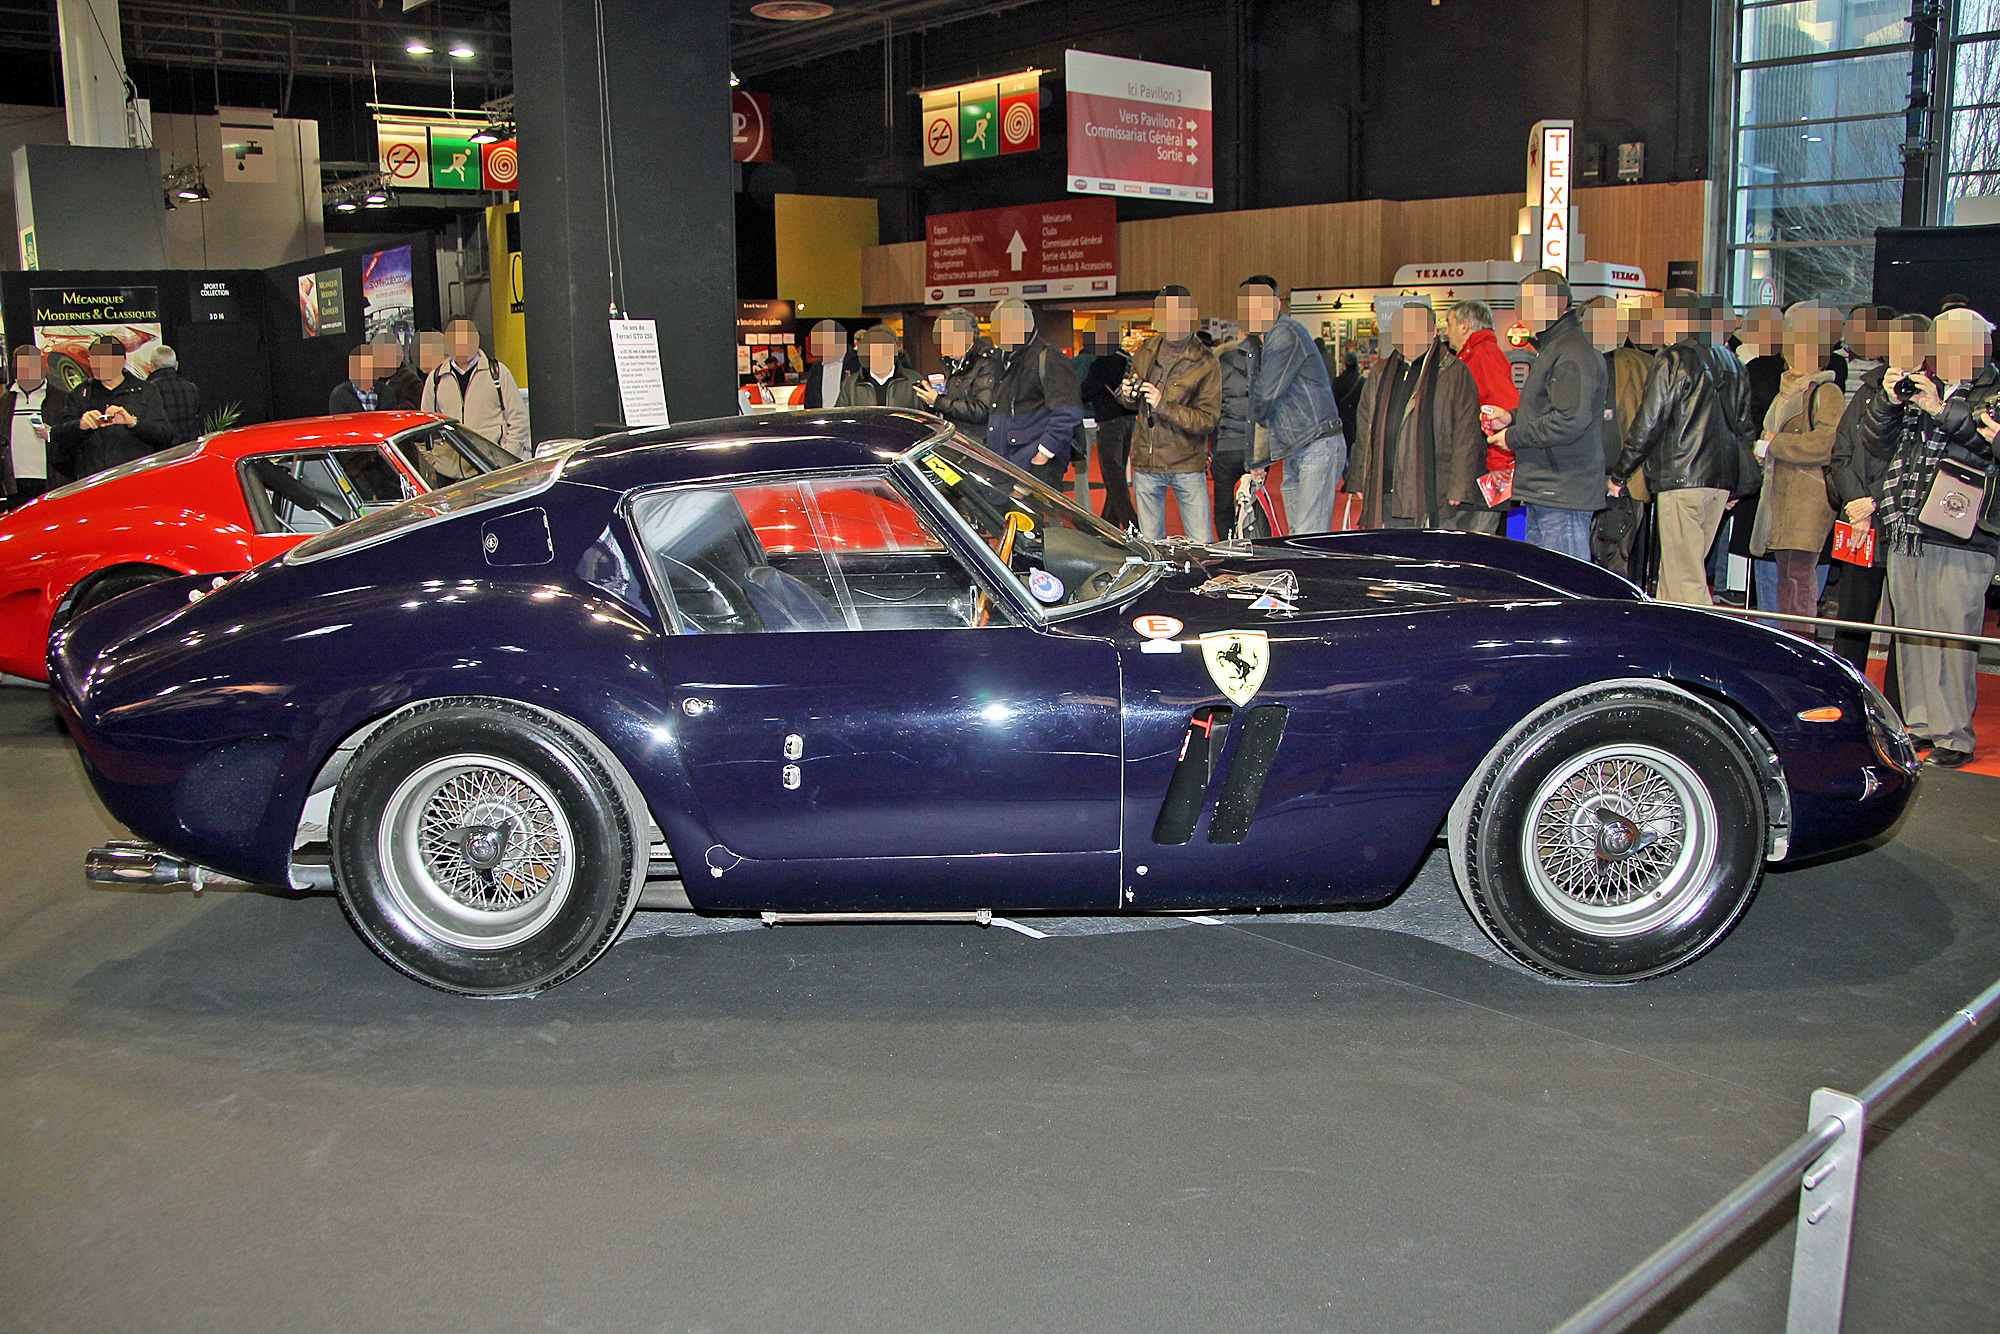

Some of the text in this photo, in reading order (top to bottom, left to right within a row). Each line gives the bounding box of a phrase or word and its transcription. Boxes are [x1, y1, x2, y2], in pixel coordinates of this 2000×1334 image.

[1127, 82, 1183, 103] Ici Pavillon 3
[1118, 108, 1184, 130] Vers Pavillon 2
[1084, 121, 1183, 147] Commissariat Général
[1156, 146, 1183, 162] Sortie
[1042, 213, 1073, 223] Miniatures
[1042, 226, 1058, 237] Clubs
[934, 236, 961, 246] Association
[961, 234, 971, 244] des
[1041, 234, 1103, 249] Commissariat Général
[1042, 249, 1084, 262] Sortie du Salon
[1059, 263, 1075, 272] Auto
[1080, 261, 1113, 271] Accessoires
[933, 271, 966, 281] Constructeurs
[1415, 267, 1465, 279] TEXACO
[1611, 270, 1640, 282] TEXACO
[200, 289, 230, 297] COLLECTION
[92, 308, 103, 320] &
[740, 318, 761, 327] boutique
[761, 318, 769, 326] du
[768, 318, 782, 326] salon
[615, 332, 633, 340] Ferrari
[644, 332, 654, 340] 250
[1147, 619, 1171, 632] E
[1228, 684, 1237, 696] S
